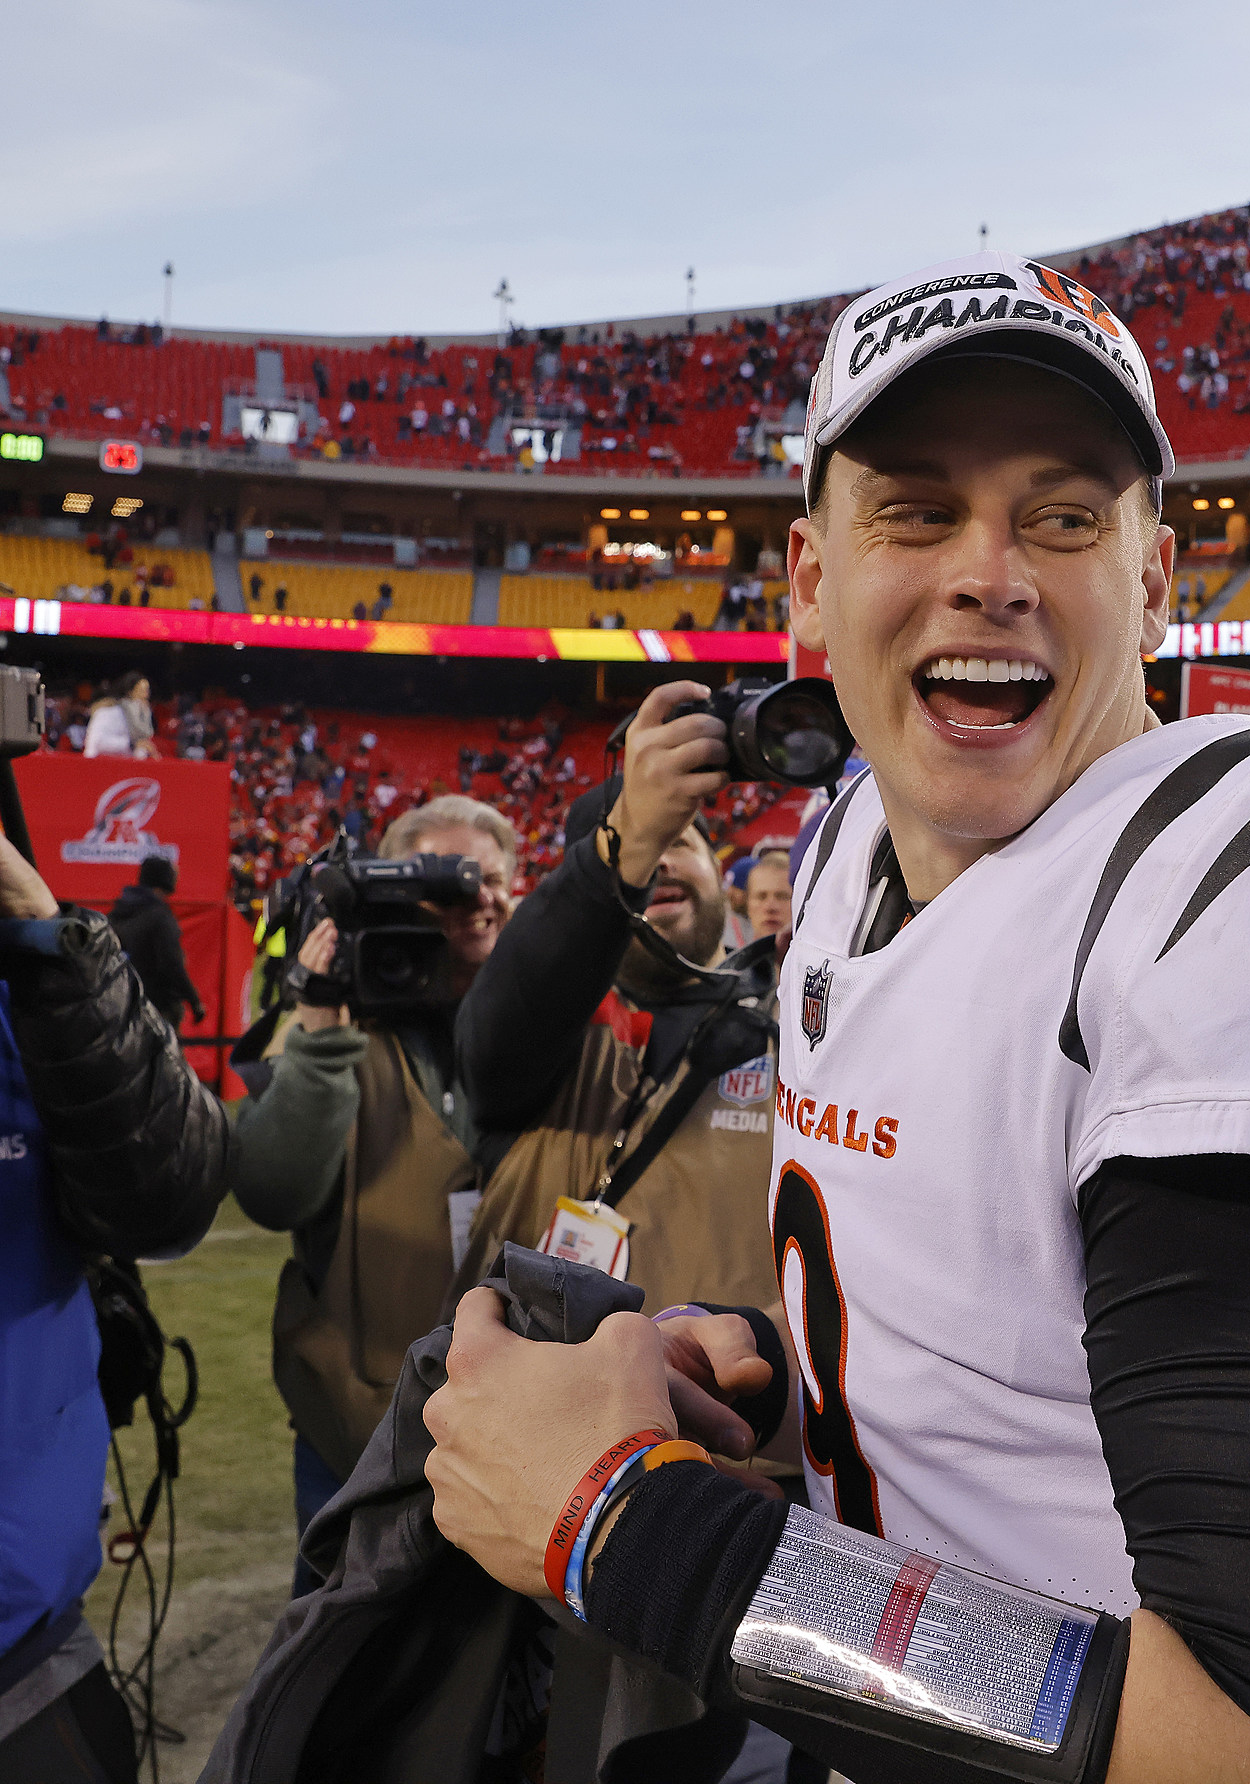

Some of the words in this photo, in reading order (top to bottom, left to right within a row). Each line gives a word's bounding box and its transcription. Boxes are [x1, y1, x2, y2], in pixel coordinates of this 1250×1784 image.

[859, 273, 1001, 326] CONFERENCE
[804, 996, 822, 1032] NFL
[726, 1071, 766, 1098] NFL
[709, 1108, 769, 1134] MEDIA
[777, 1080, 900, 1159] ENGALS
[771, 1158, 886, 1540] 9
[553, 1494, 585, 1550] MIND
[588, 1435, 643, 1483] HEART
